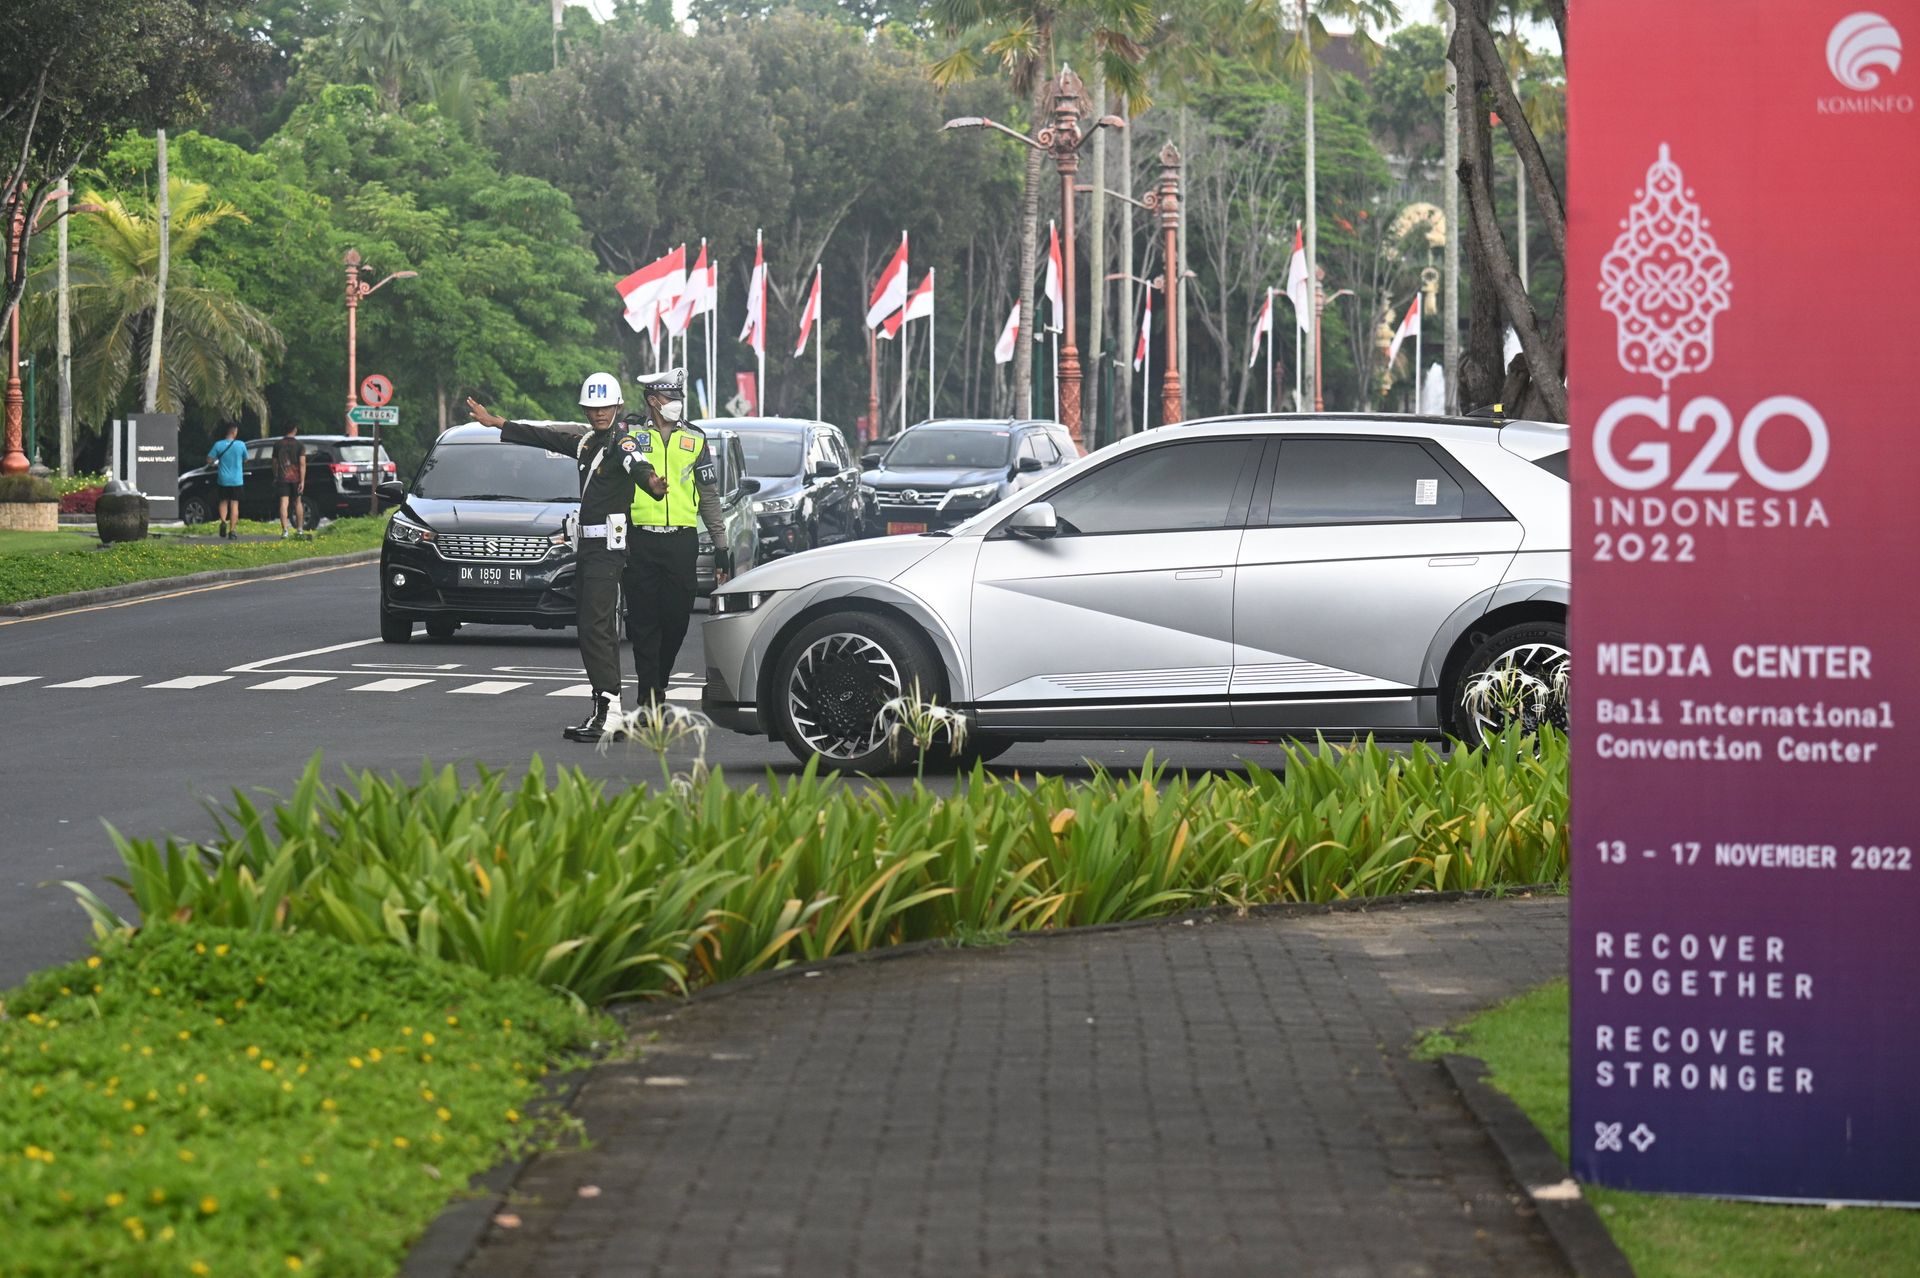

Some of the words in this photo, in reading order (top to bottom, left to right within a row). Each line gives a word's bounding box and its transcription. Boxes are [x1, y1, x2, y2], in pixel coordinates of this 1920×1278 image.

[1816, 95, 1915, 114] KOMINFO
[588, 384, 607, 399] PM
[1592, 394, 1830, 492] G20
[1593, 496, 1829, 528] INDONESIA
[1593, 532, 1695, 562] 2022
[461, 567, 473, 579] DK
[480, 568, 502, 580] 1850
[509, 568, 522, 580] EN
[1597, 643, 1711, 677] MEDIA
[1732, 644, 1872, 679] CENTER
[1596, 698, 1662, 725] Bali
[1679, 699, 1894, 729] International
[1596, 733, 1762, 761] Convention
[1777, 736, 1879, 763] Center
[1596, 840, 1627, 864] 13
[1671, 842, 1702, 865] 17
[1715, 843, 1837, 868] NOVEMBER
[1851, 845, 1912, 870] 2022
[1595, 931, 1784, 963] RECOVER
[1595, 967, 1813, 999] TOGETHER
[1596, 1024, 1785, 1057] RECOVER
[1596, 1061, 1813, 1094] STRONGER
